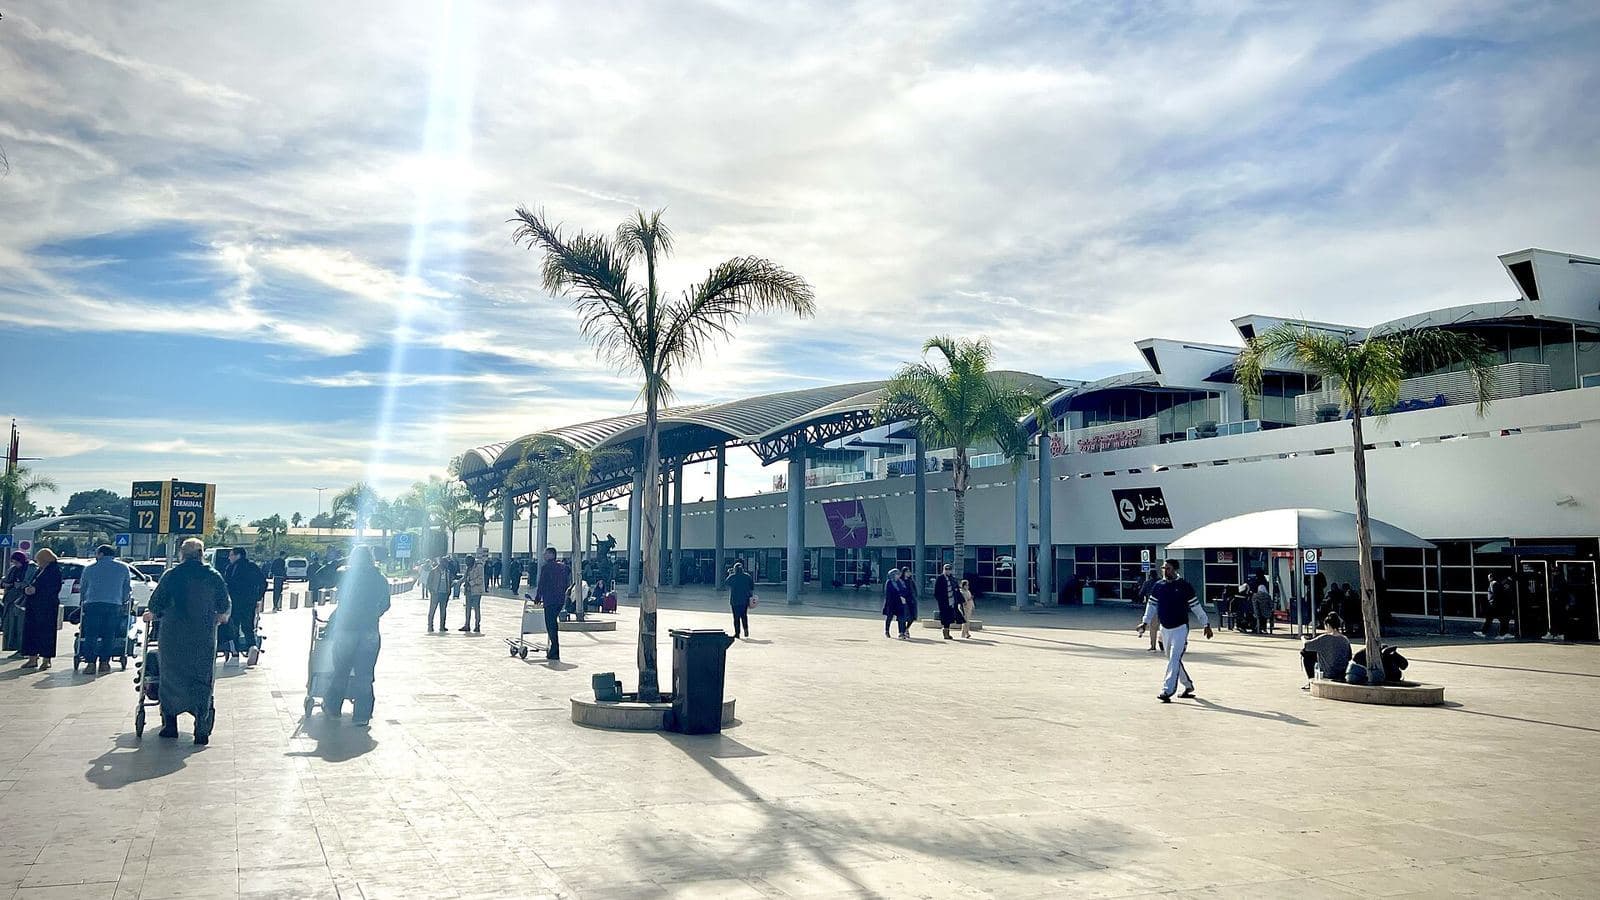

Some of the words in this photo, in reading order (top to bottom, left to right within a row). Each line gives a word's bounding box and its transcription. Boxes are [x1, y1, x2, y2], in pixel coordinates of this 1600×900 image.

[173, 486, 202, 498] محطة
[133, 499, 159, 507] TERMINAL
[173, 499, 202, 508] TERMINAL
[1137, 494, 1164, 511] دخول
[137, 510, 154, 529] T2
[177, 511, 196, 529] T2
[1141, 516, 1170, 525] Entrance
